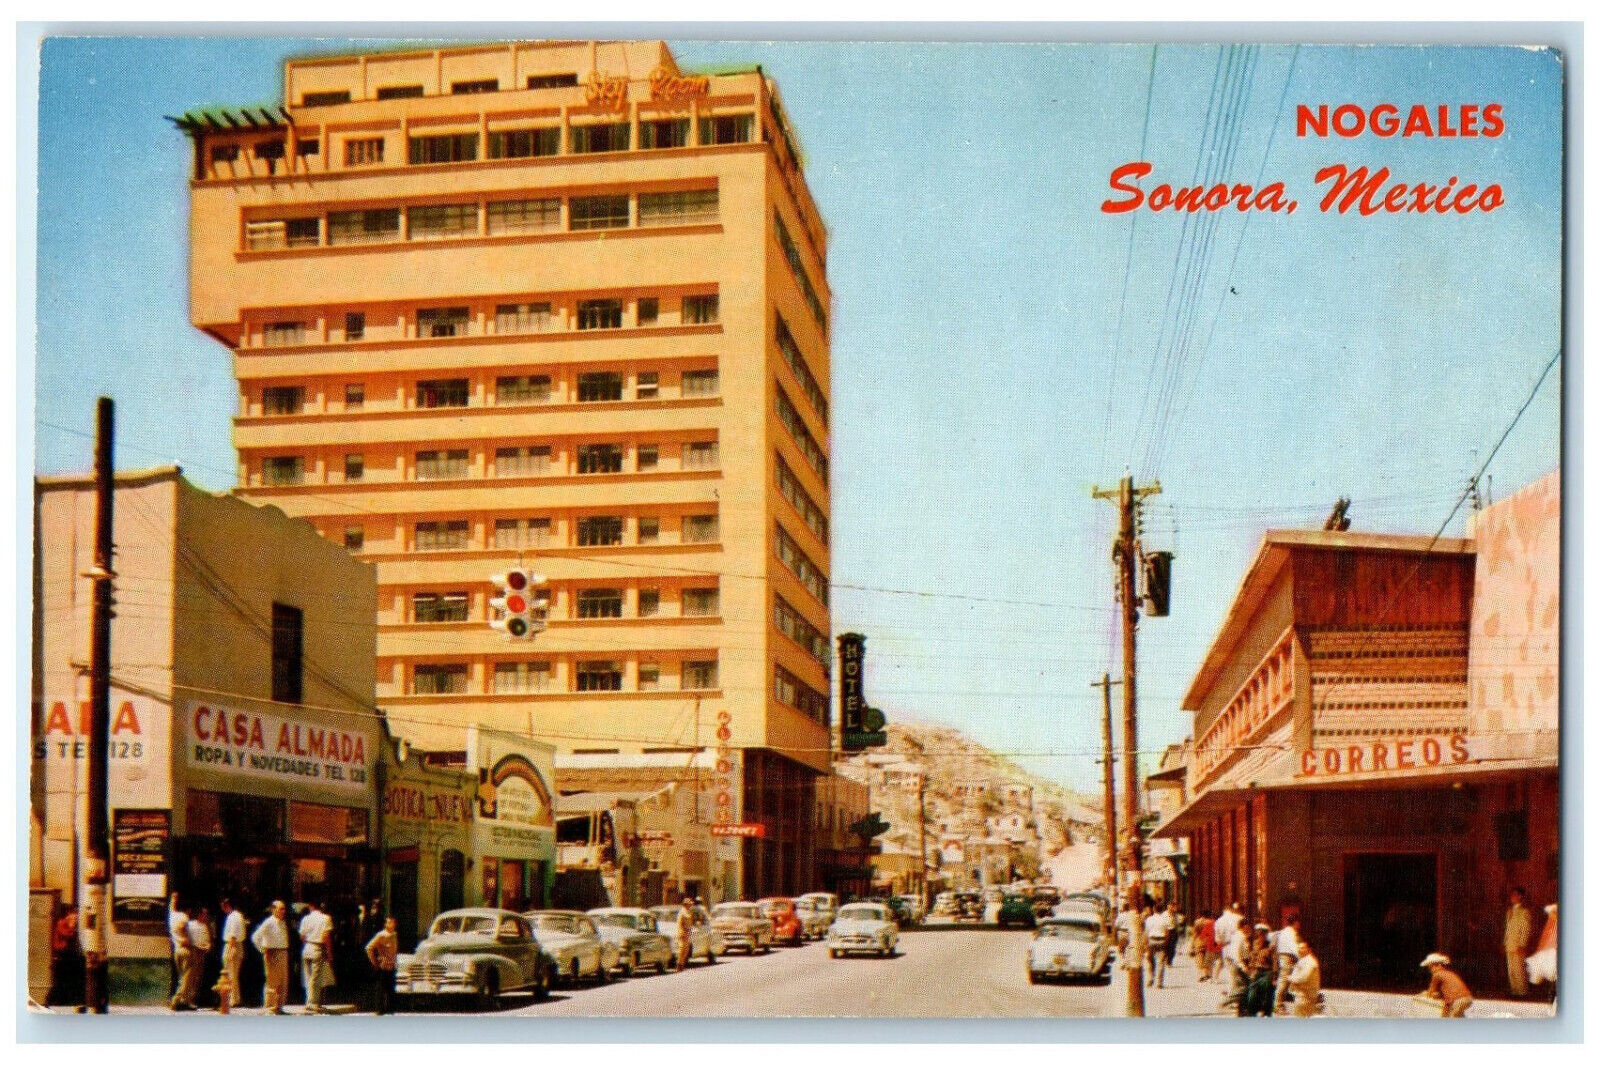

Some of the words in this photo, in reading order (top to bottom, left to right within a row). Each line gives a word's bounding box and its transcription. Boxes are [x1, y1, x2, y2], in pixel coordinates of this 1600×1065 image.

[585, 71, 627, 110] Sky
[649, 66, 709, 101] Room
[845, 642, 859, 729] HOTEL
[110, 741, 143, 759] 128
[194, 706, 264, 750] CASA
[276, 721, 366, 765] ALMADA
[1301, 734, 1469, 777] CORREOS
[195, 745, 232, 766] ROPA
[236, 751, 246, 768] Y
[250, 754, 320, 777] NOVEDADES
